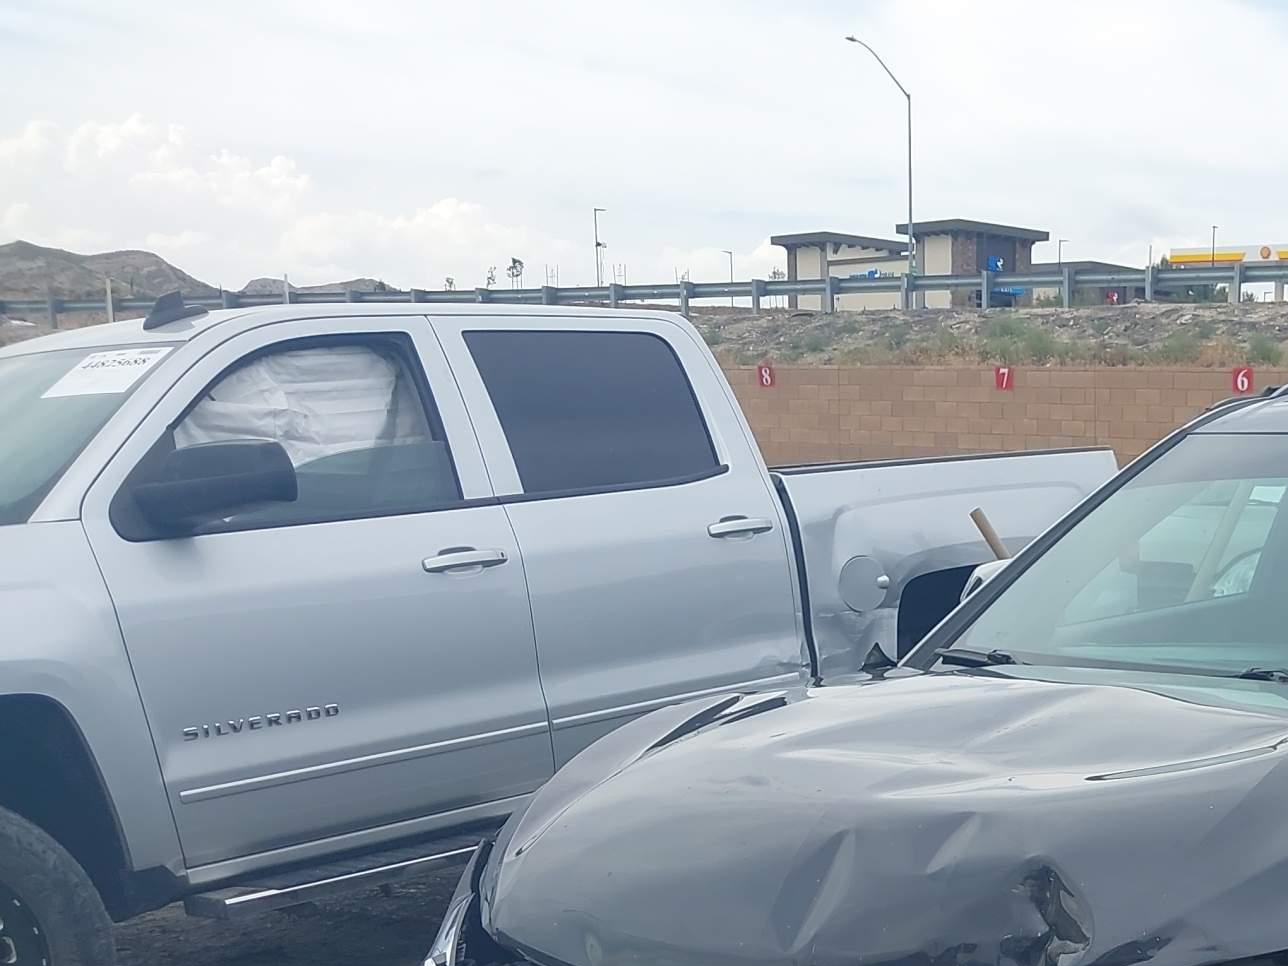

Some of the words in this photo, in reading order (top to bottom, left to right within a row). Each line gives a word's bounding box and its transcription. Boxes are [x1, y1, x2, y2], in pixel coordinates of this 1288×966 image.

[761, 367, 771, 386] 8
[999, 368, 1009, 389] 7
[1236, 369, 1249, 391] 6
[182, 703, 340, 742] SILVERADO
